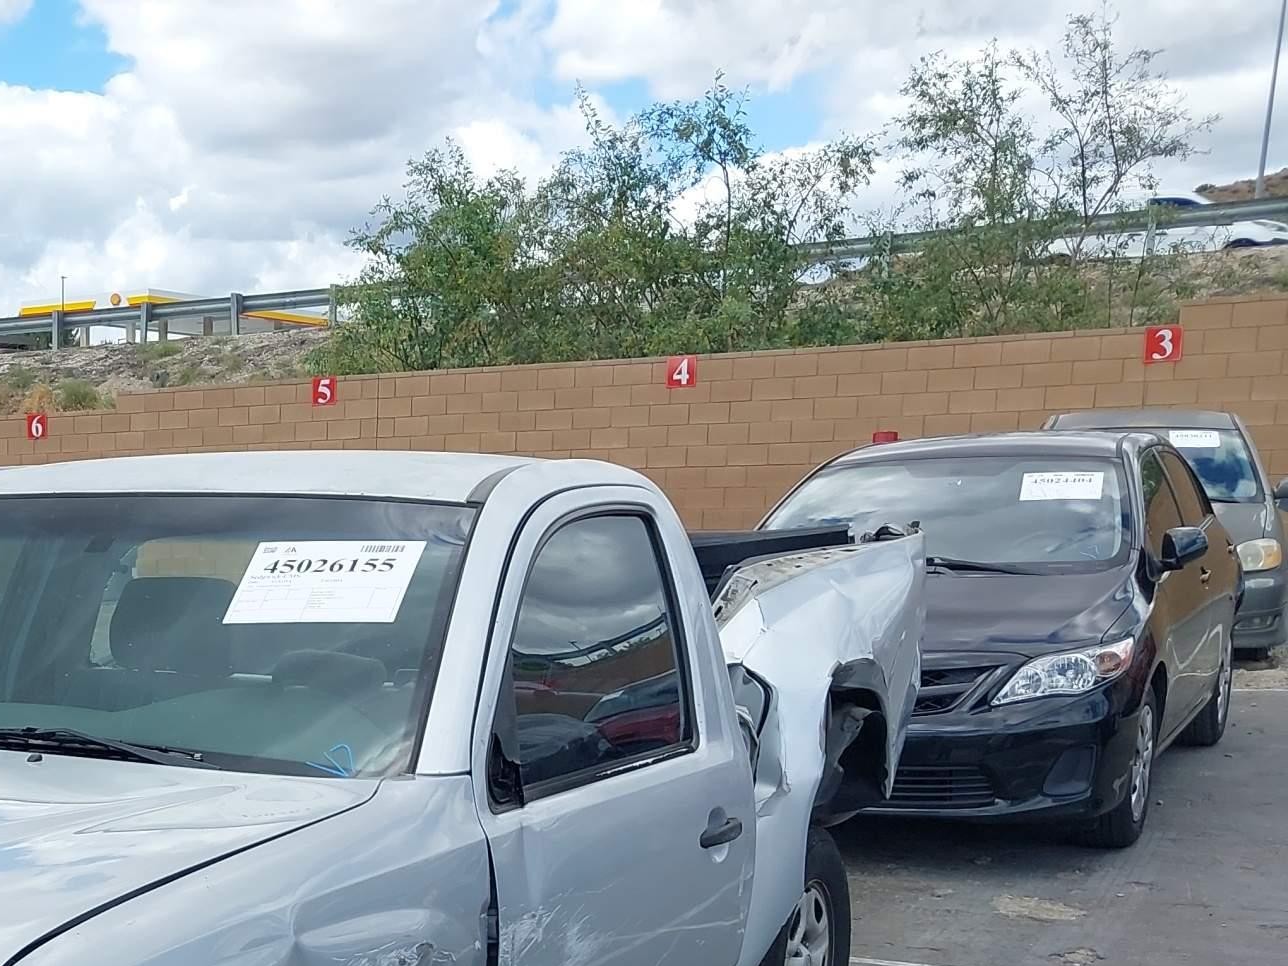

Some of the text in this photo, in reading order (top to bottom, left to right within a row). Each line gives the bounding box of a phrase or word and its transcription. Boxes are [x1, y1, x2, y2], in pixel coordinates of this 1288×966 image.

[1151, 329, 1173, 359] 3
[673, 358, 690, 385] 4
[317, 379, 331, 404] 5
[31, 415, 43, 437] 6
[263, 558, 397, 574] 45026155
